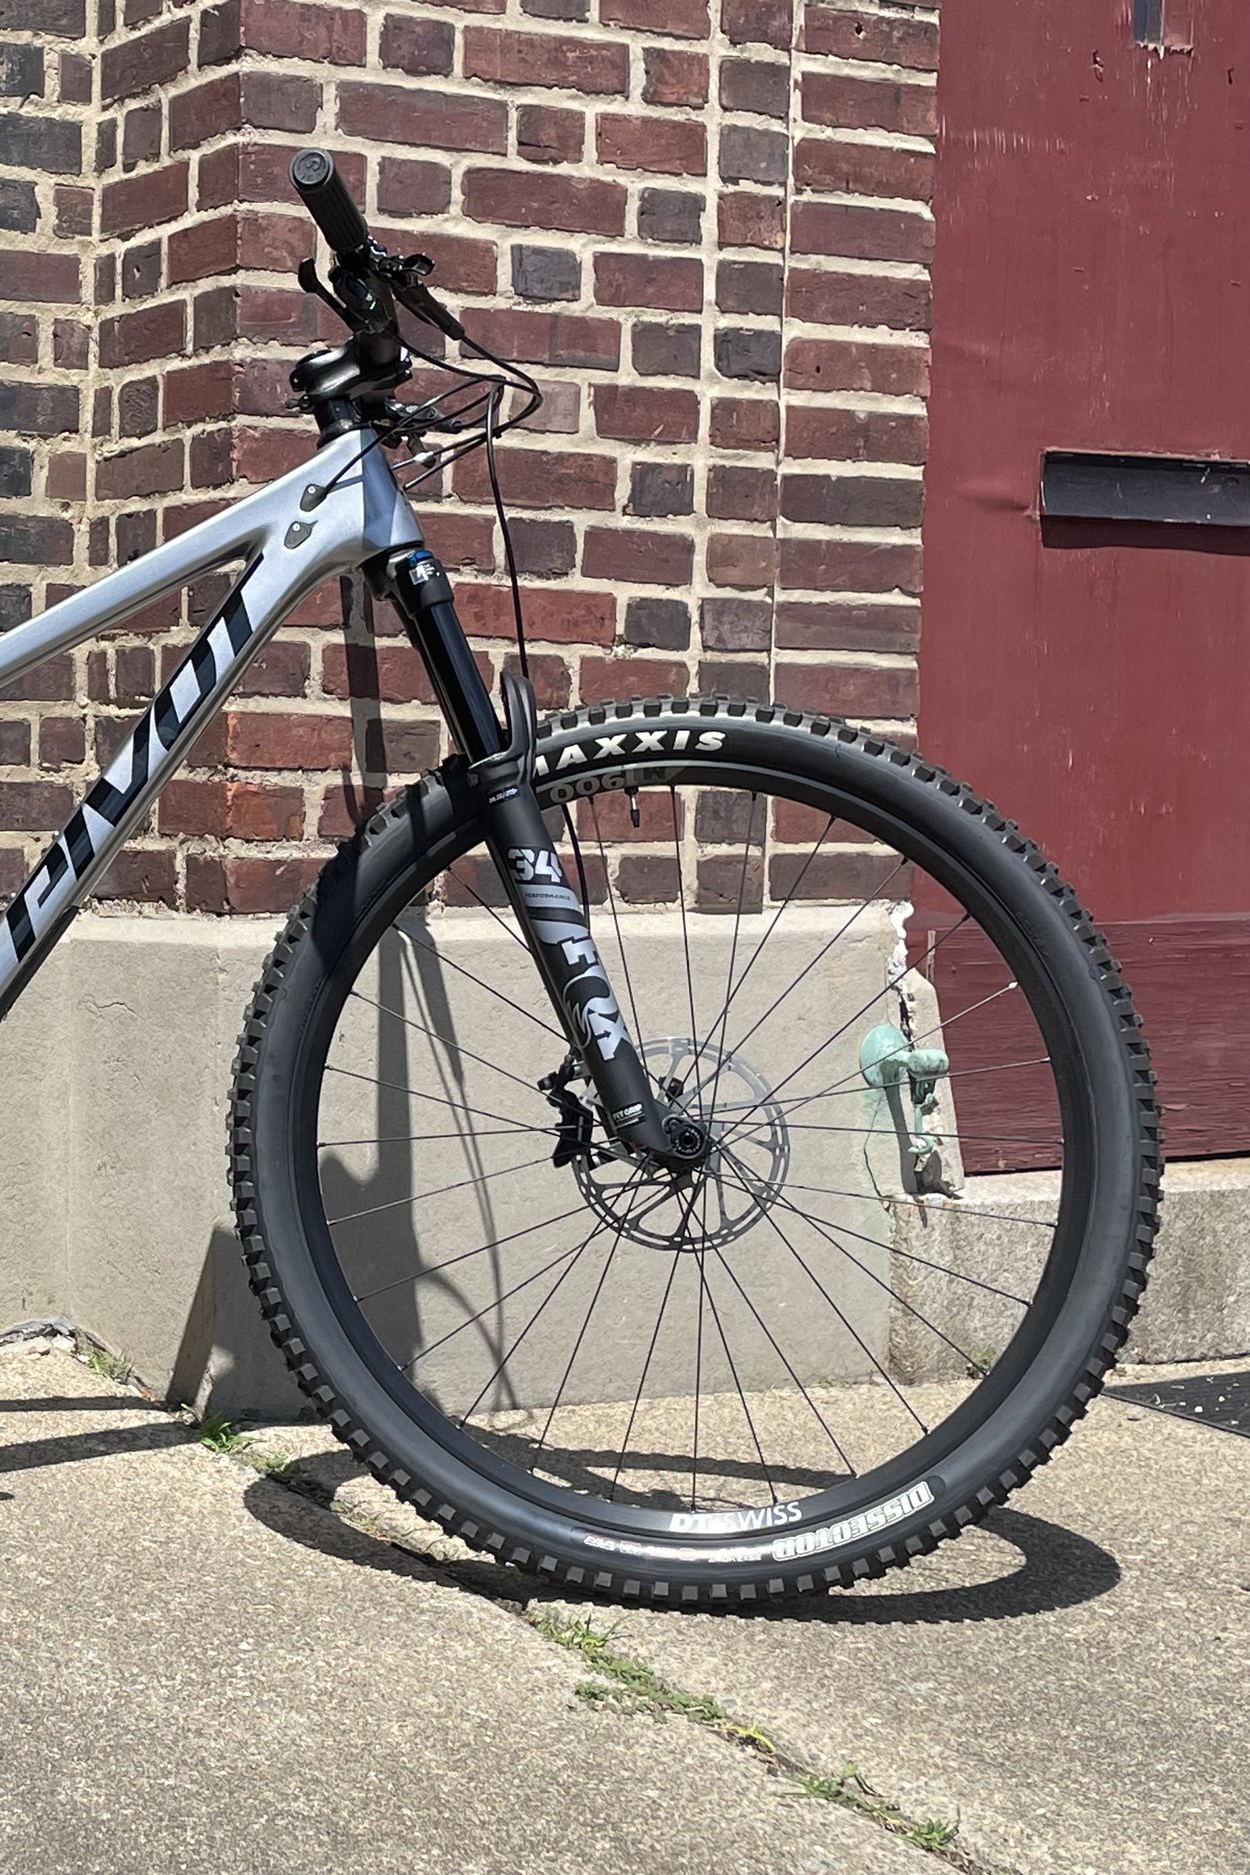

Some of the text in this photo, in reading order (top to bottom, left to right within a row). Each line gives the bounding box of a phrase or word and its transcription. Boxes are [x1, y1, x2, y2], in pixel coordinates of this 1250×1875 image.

[6, 552, 264, 963] PIVOT
[507, 848, 563, 883] 34
[561, 939, 633, 1061] FOX
[668, 1501, 803, 1533] DT SWISS
[771, 1480, 936, 1563] DISSECTOR
